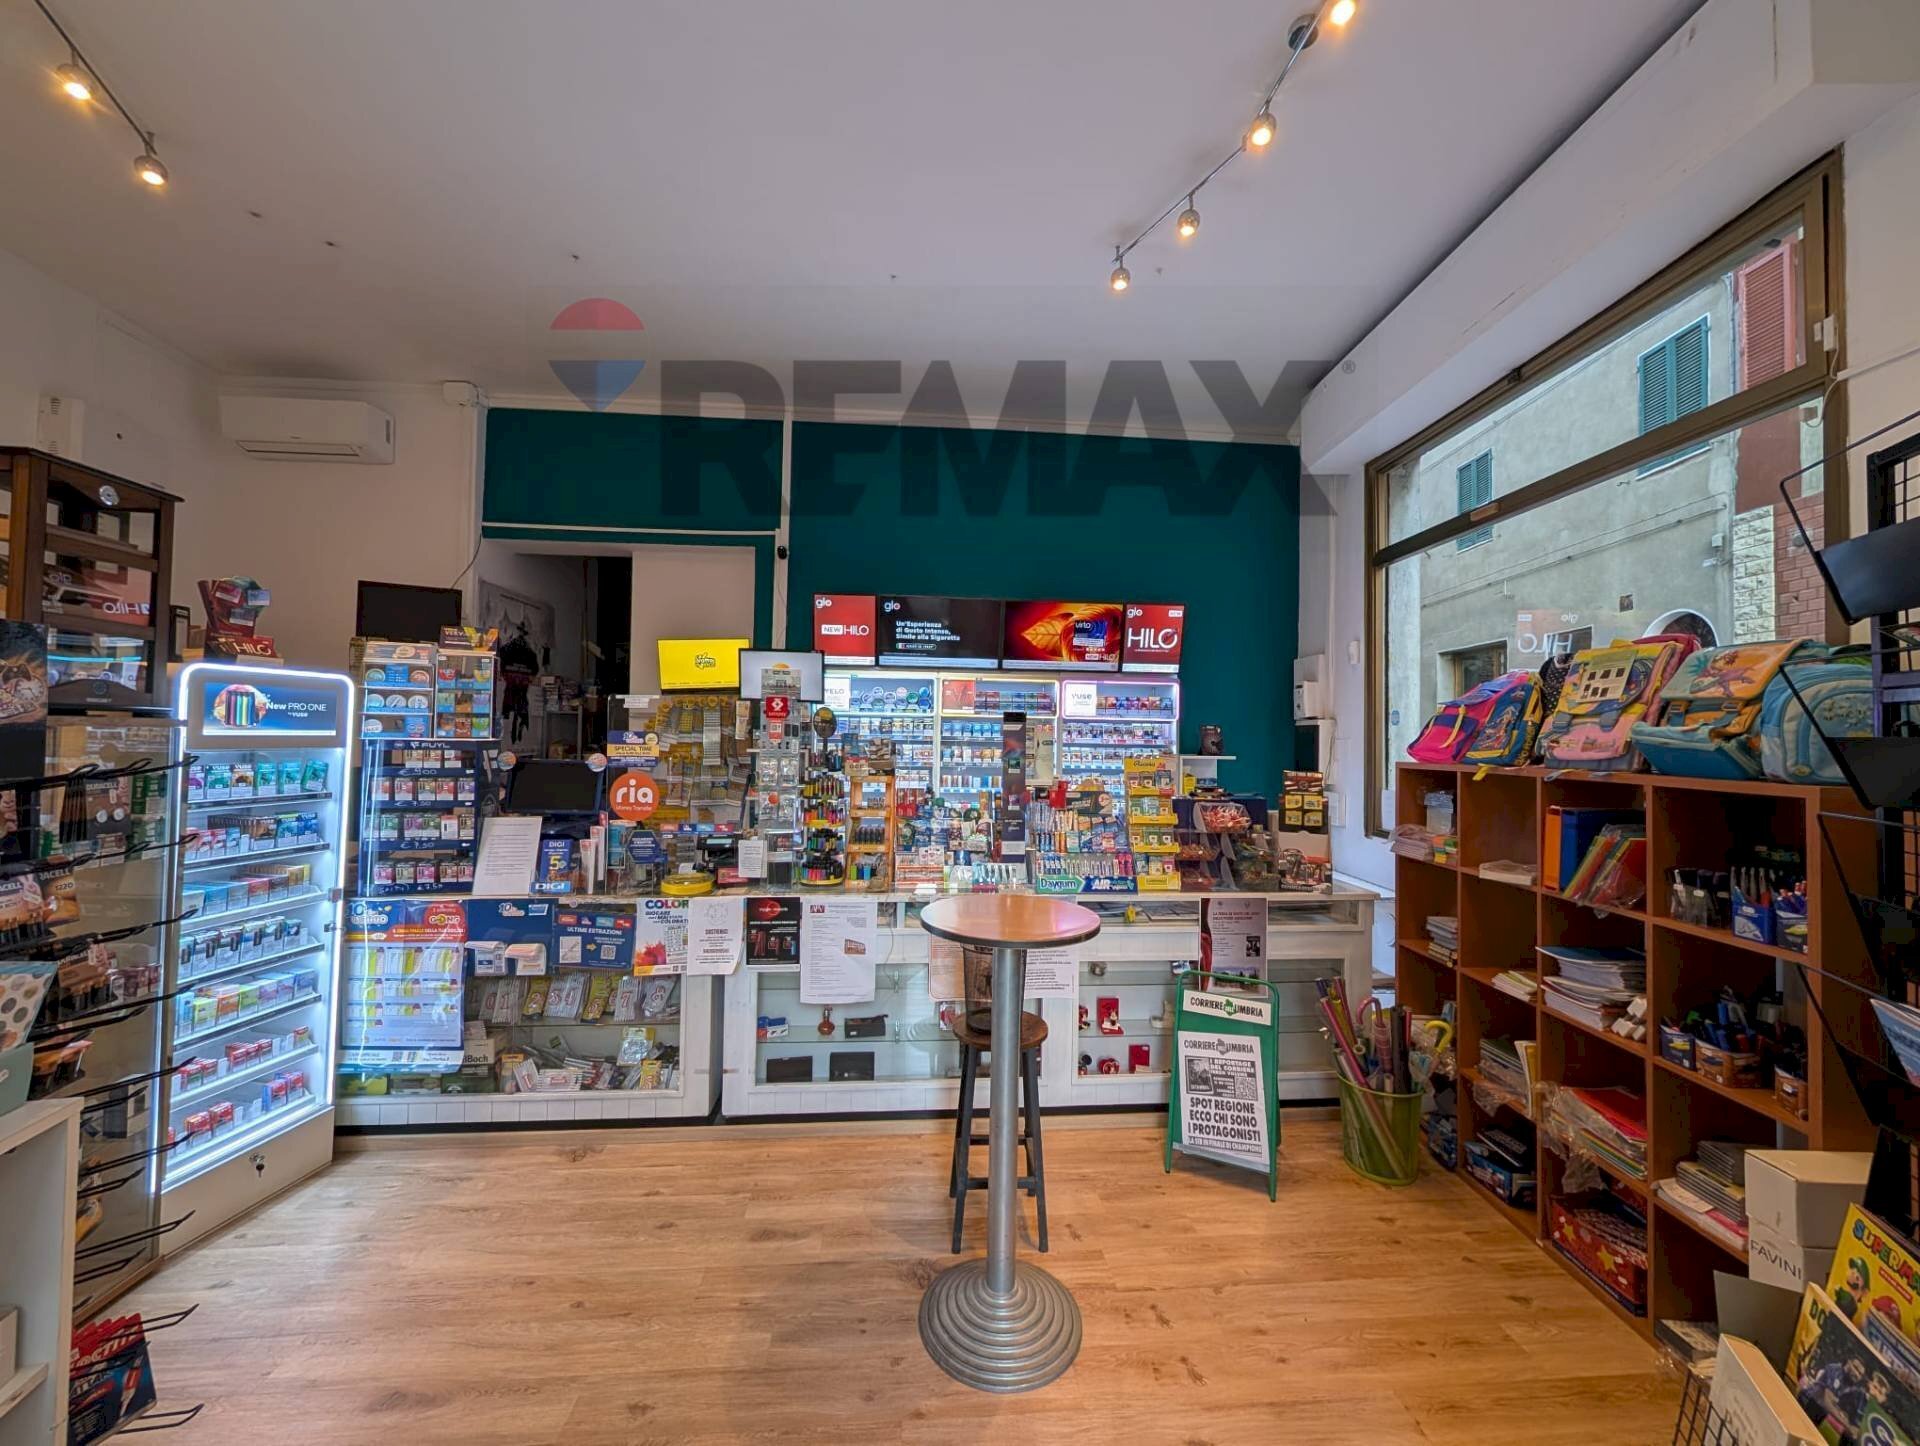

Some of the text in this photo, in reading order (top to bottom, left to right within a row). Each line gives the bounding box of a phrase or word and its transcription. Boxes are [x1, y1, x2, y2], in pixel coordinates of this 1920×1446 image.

[815, 597, 832, 609] glo
[884, 600, 900, 612] glo
[1127, 607, 1143, 618] glo
[824, 625, 869, 636] NEW HILO
[904, 627, 923, 635] Gusto
[1128, 627, 1178, 649] HILO
[233, 642, 272, 656] HILO
[266, 702, 327, 711] New PRO ONE
[86, 782, 119, 791] DURACELL
[616, 779, 653, 804] ria
[55, 882, 74, 891] 1220
[1040, 878, 1077, 890] Daygum
[429, 915, 461, 925] GONG
[1190, 997, 1223, 1011] CORRIERE
[1234, 1004, 1263, 1017] UMBRIA
[1184, 1039, 1254, 1054] CORRIERE UMBRIA
[1214, 1058, 1251, 1067] REPORTAGE
[1190, 1097, 1255, 1114] SPOT REGIONE
[1190, 1109, 1257, 1128] ECCO CHI SONO
[1193, 1123, 1261, 1142] PROTAGONISTI
[1751, 1239, 1801, 1280] FAVINI
